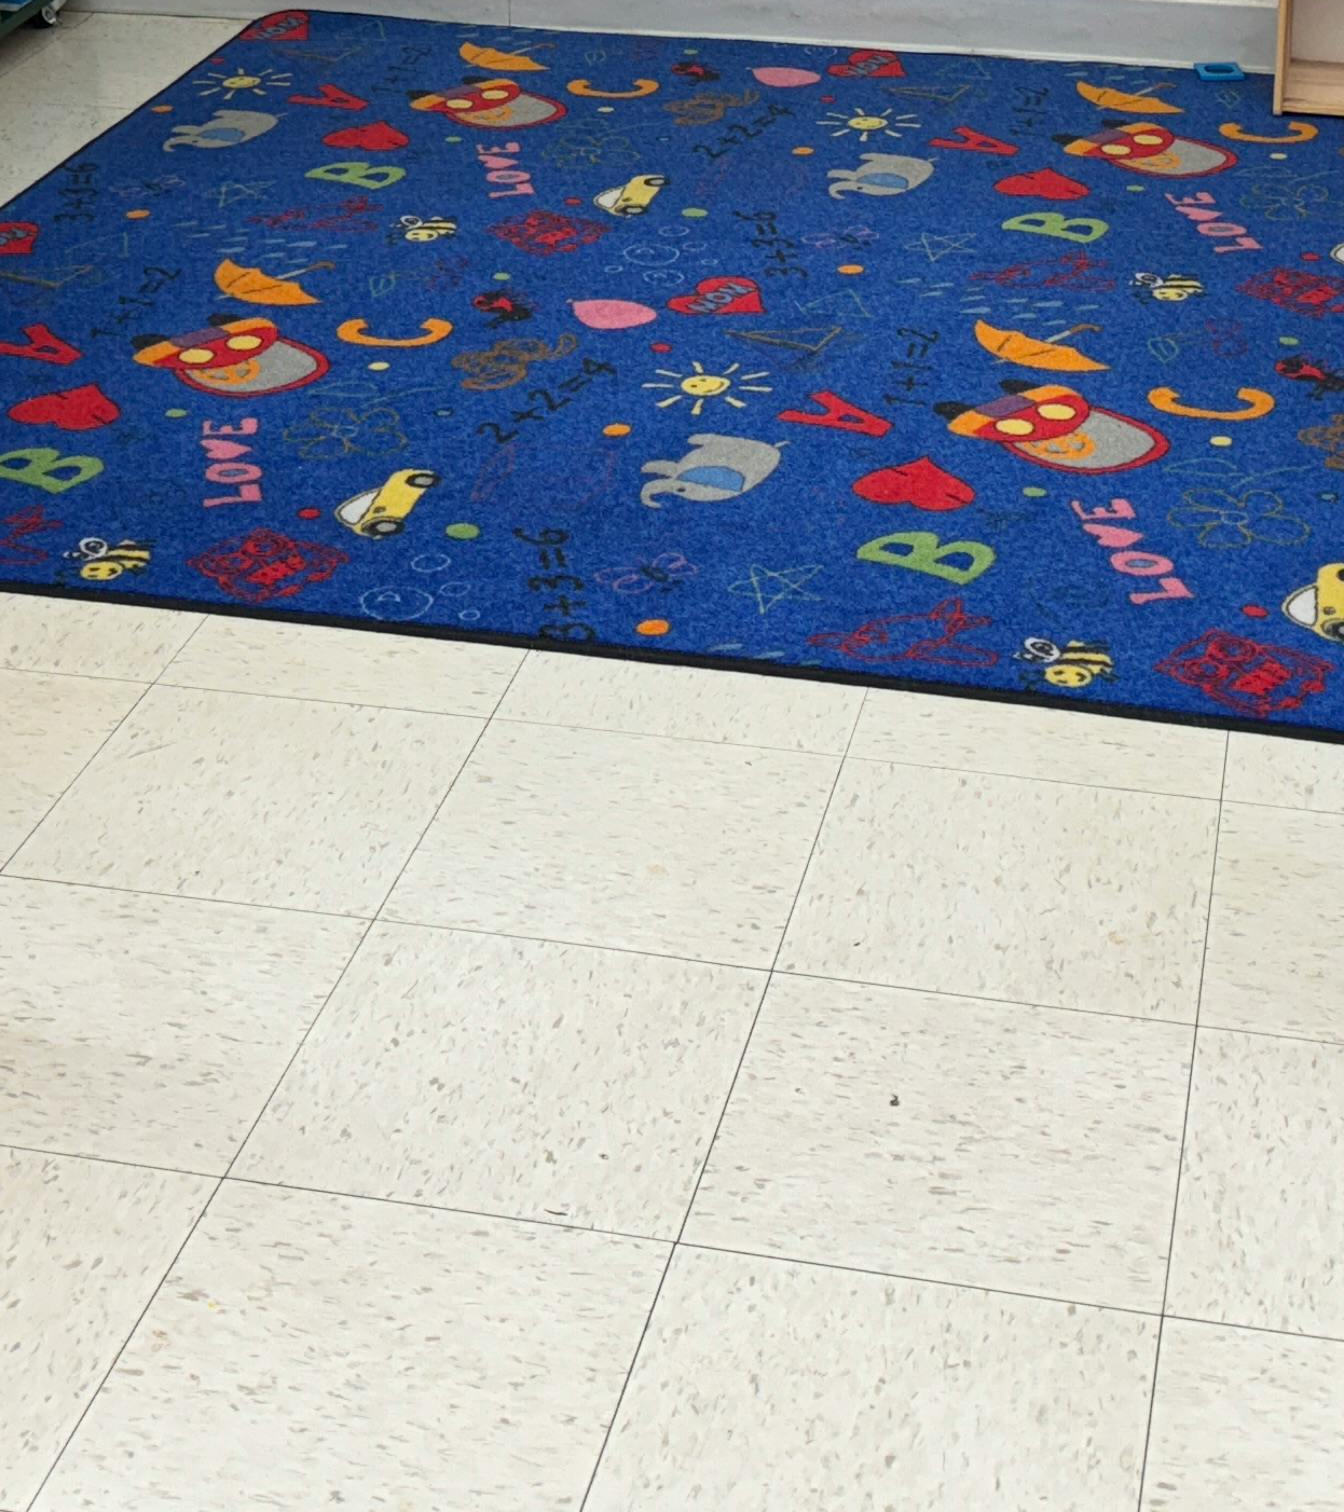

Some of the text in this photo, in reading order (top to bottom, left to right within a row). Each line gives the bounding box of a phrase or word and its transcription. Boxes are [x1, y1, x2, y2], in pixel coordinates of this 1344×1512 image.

[928, 125, 1020, 156] A
[304, 161, 408, 190] B
[476, 141, 537, 199] LOVE
[1001, 211, 1110, 244] B
[1163, 190, 1265, 255] LOVE
[336, 316, 455, 348] C
[776, 390, 894, 438] A
[1146, 387, 1277, 422] C
[201, 416, 265, 509] LOVE
[856, 530, 997, 585] B
[1069, 497, 1196, 606] LOVE
